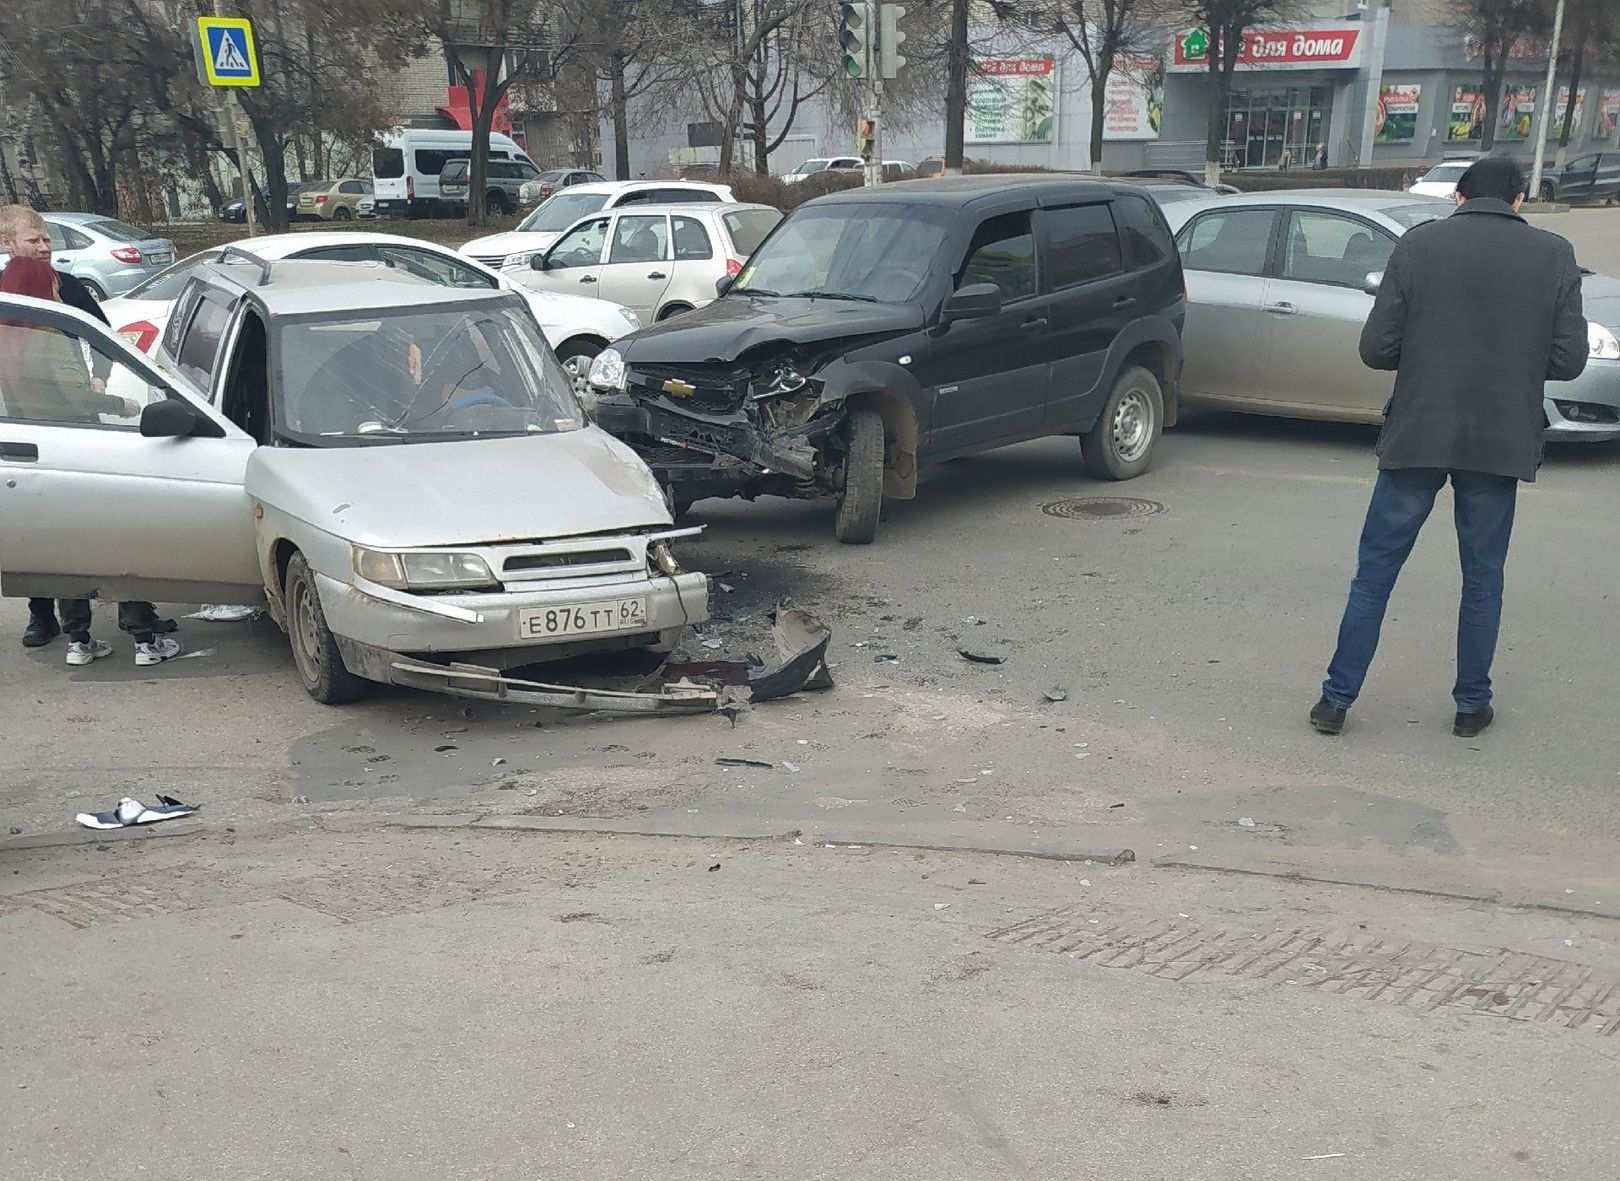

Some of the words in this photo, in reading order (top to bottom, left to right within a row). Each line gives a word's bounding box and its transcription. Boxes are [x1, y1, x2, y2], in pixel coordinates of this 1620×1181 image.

[1252, 36, 1288, 58] для
[1292, 34, 1344, 57] дома
[620, 600, 639, 619] 62
[620, 618, 634, 626] RUS
